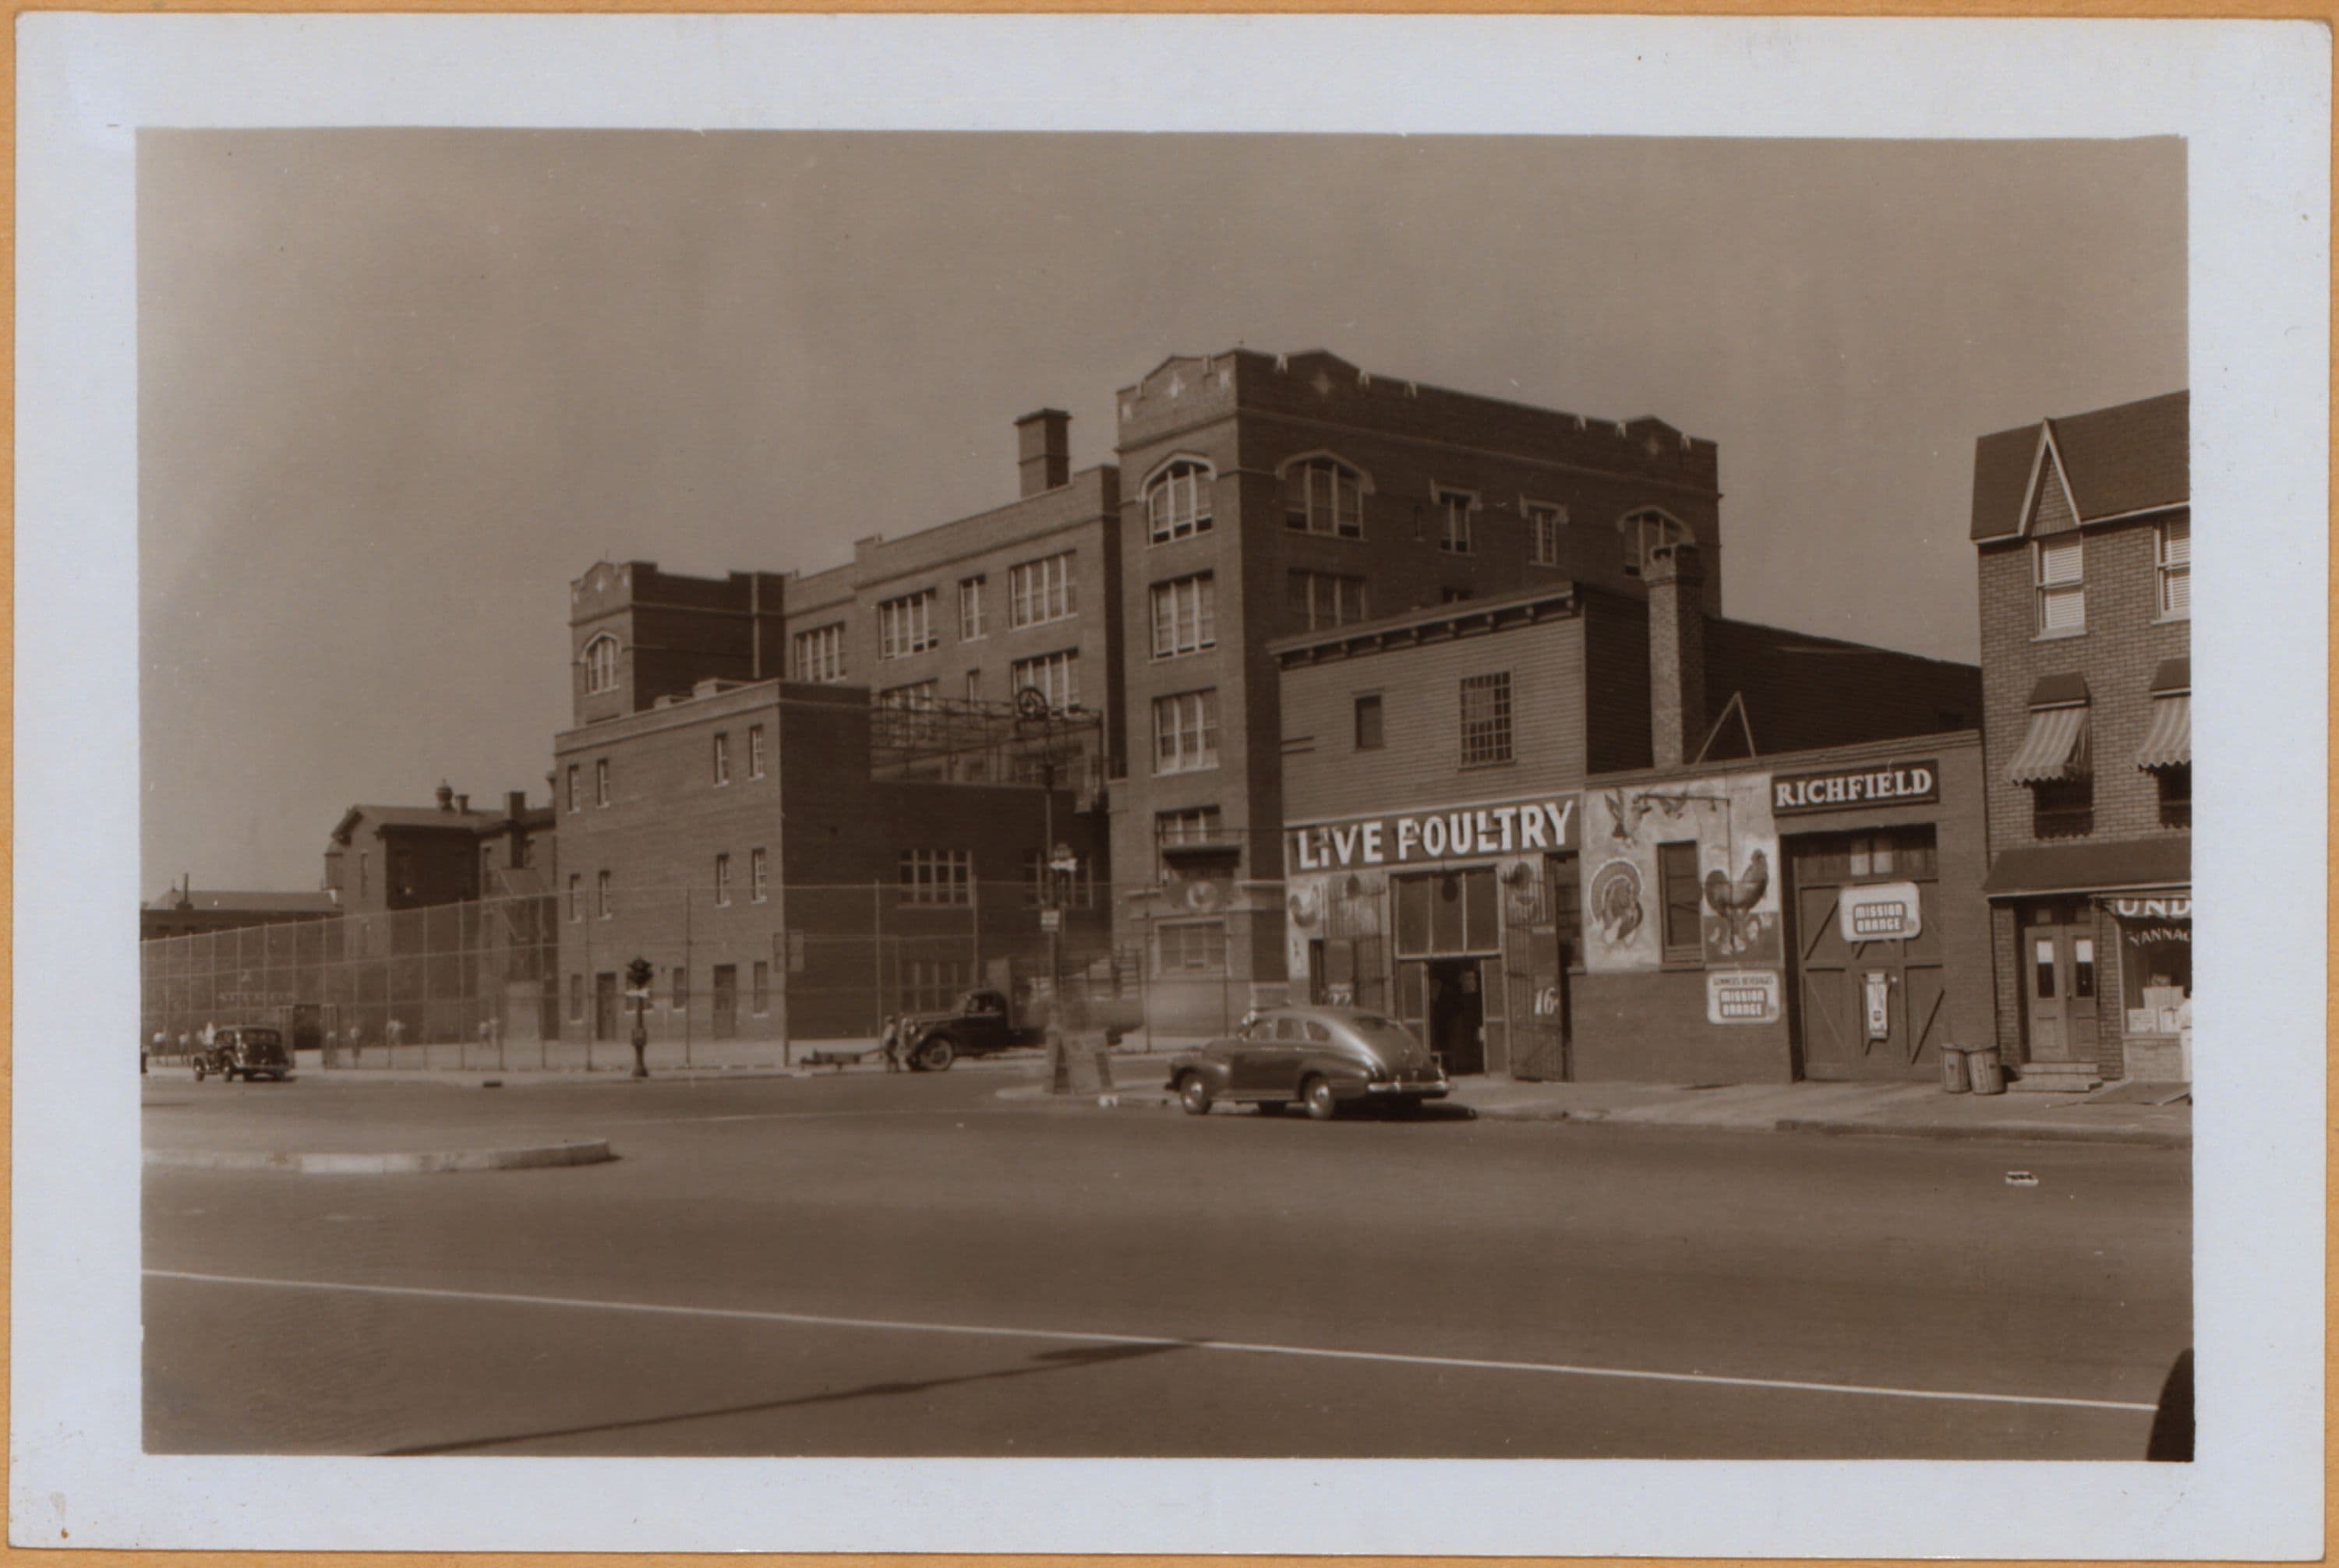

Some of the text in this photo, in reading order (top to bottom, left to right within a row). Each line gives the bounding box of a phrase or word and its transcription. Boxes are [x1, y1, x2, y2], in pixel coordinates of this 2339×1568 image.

[1775, 768, 1932, 807] RICHFIELD
[1297, 800, 1574, 871] LIVE POULTRY
[1855, 903, 1903, 919] MISSION
[1856, 917, 1901, 933] ORANGE
[1720, 990, 1765, 1002] MISSION
[1722, 1003, 1762, 1016] ORANGE
